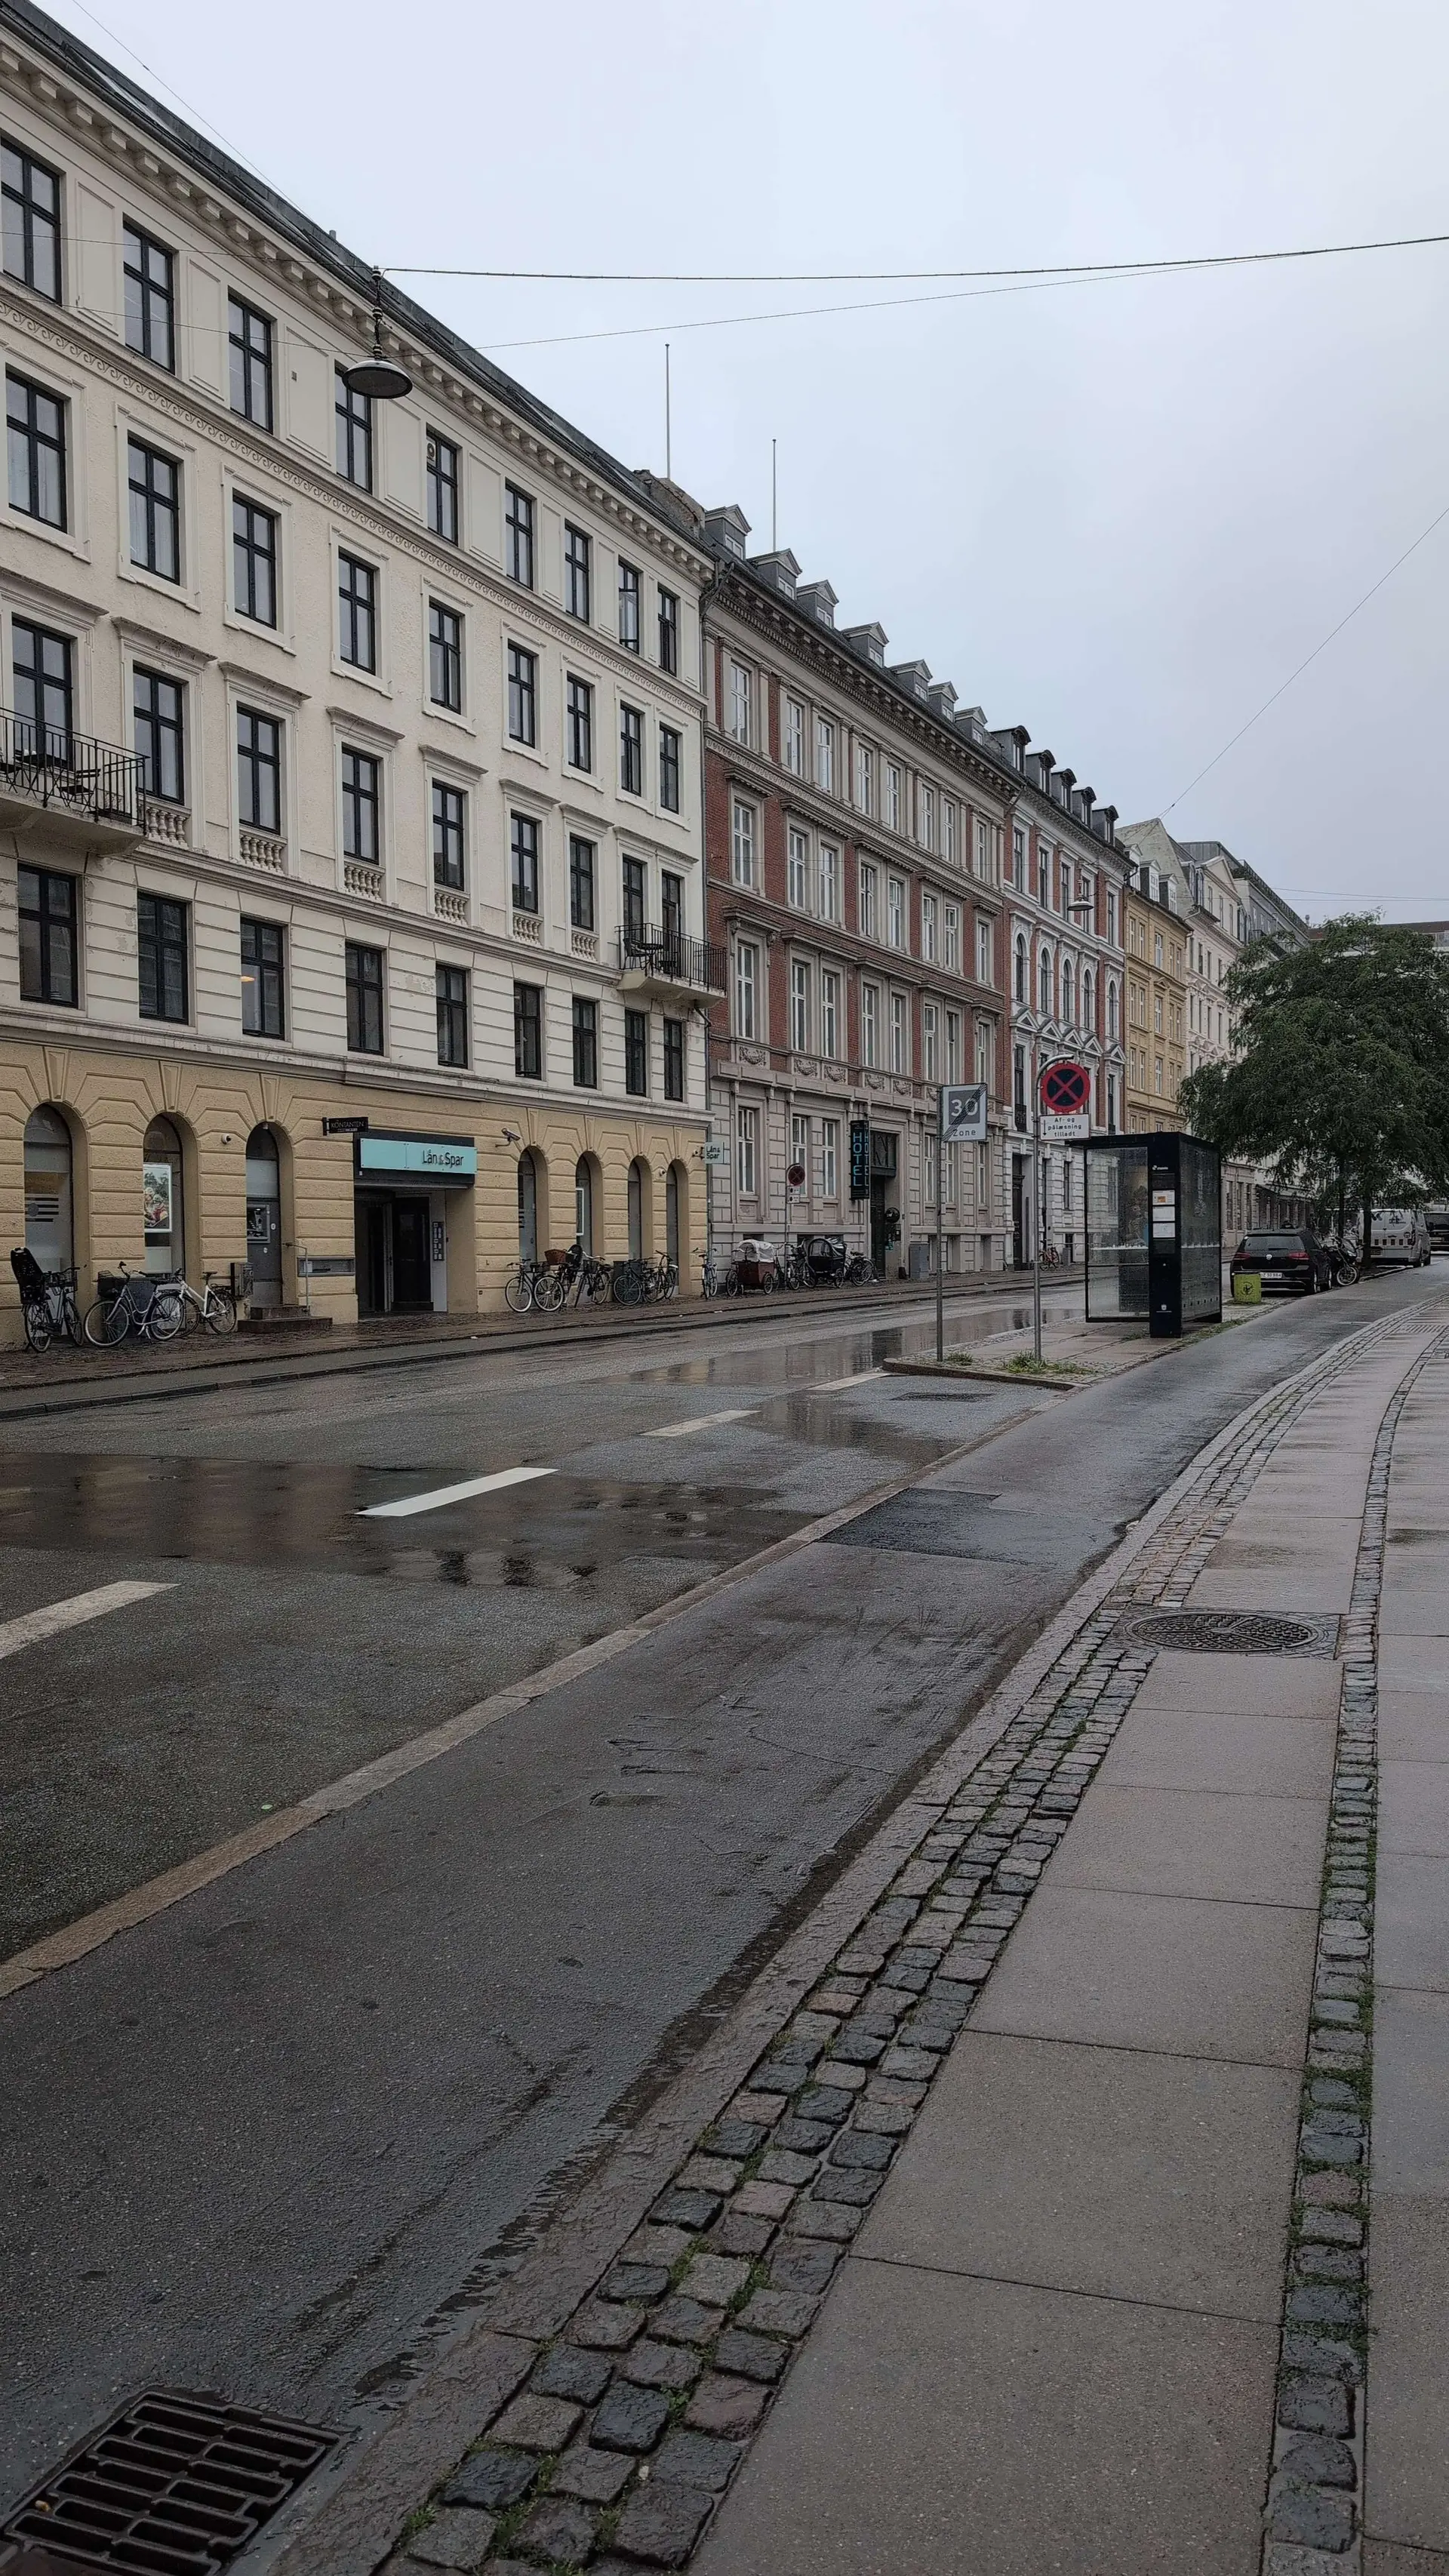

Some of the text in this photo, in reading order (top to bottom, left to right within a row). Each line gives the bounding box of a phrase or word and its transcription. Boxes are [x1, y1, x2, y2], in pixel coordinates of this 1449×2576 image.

[951, 1098, 979, 1117] 30
[952, 1128, 977, 1137] Zone
[422, 1149, 438, 1165] Lån
[445, 1152, 465, 1169] Spar
[706, 1152, 721, 1160] Spar
[853, 1132, 863, 1186] HOTEL
